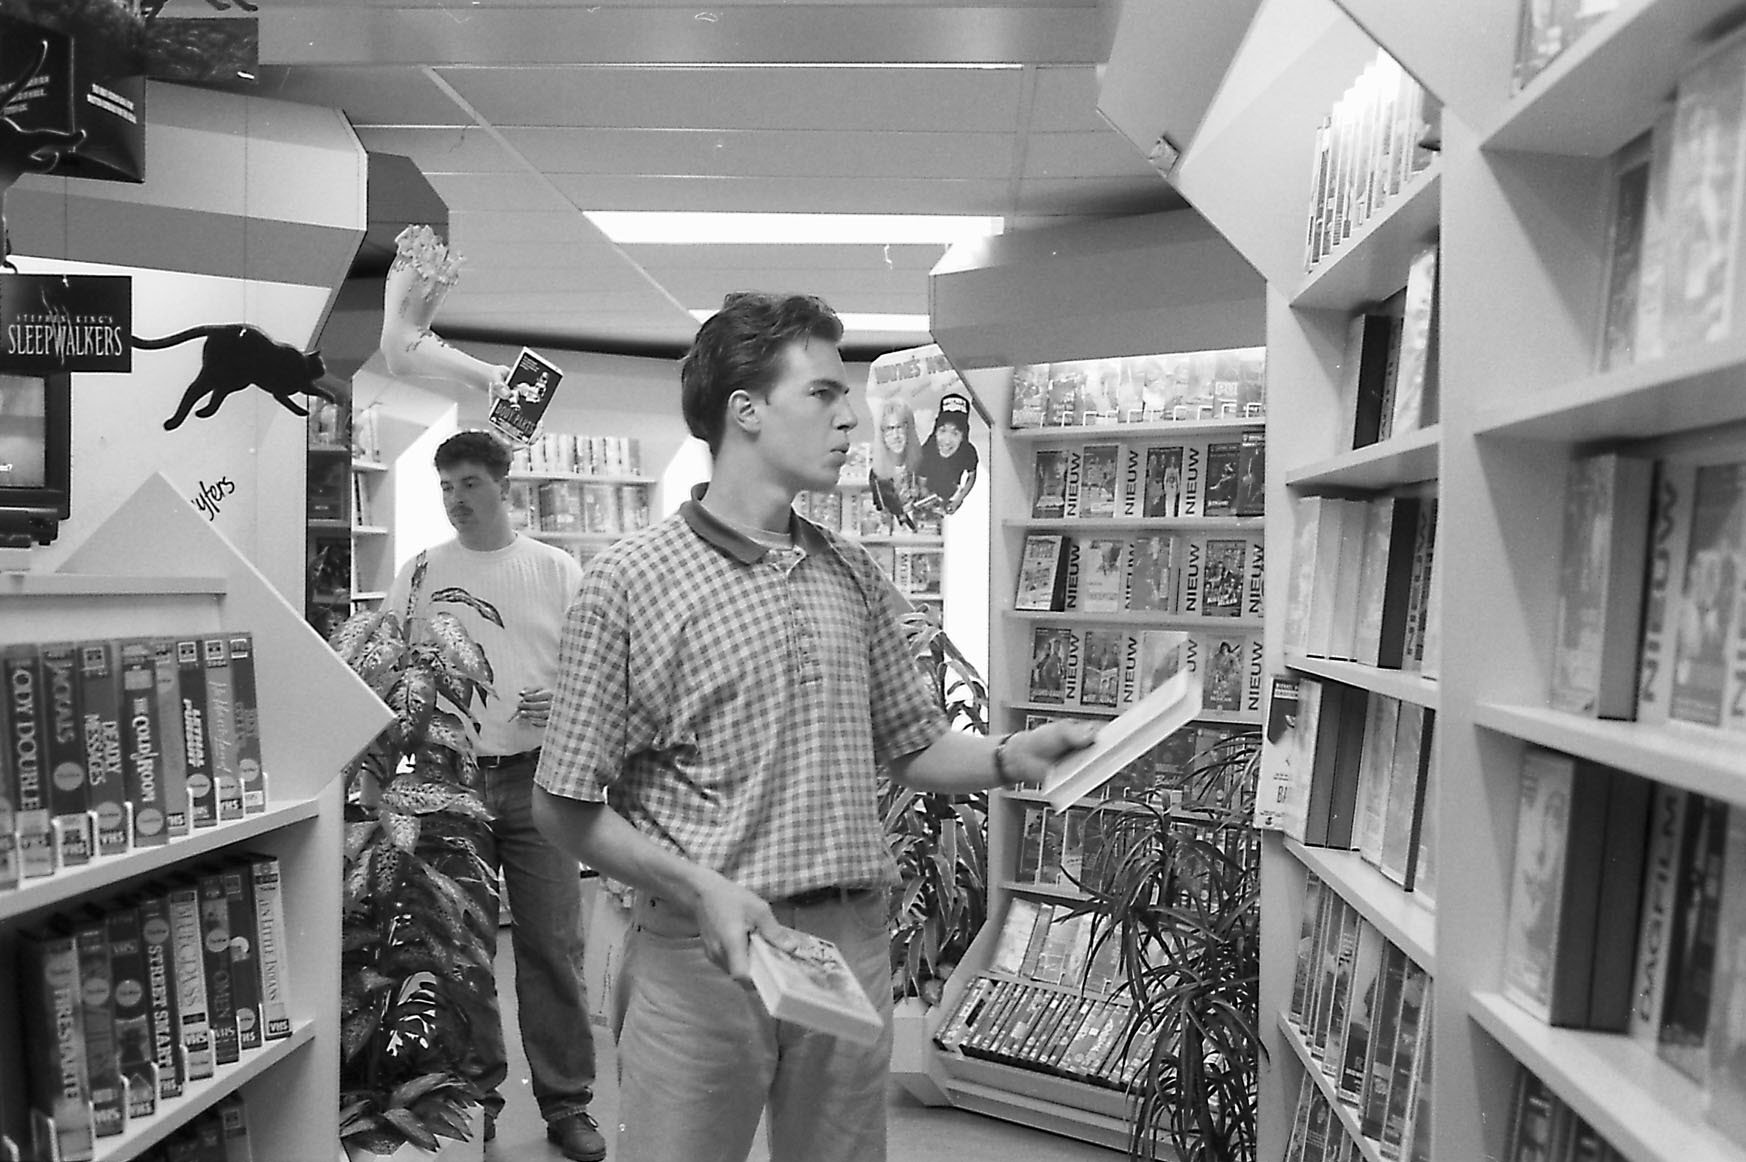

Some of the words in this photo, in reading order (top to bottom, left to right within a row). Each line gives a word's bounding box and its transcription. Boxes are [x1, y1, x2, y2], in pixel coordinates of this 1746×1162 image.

[8, 324, 122, 358] SLEEPWALKERS
[1067, 452, 1081, 516] NIEUW
[1124, 450, 1139, 516] NIEUW
[1185, 448, 1200, 515] NIEUW
[1067, 545, 1080, 609] NIEUW
[1186, 544, 1200, 611] NIEUW
[1249, 544, 1264, 613] NIEUW
[1066, 634, 1080, 699] NIEUW
[1123, 637, 1138, 703] NIEUW
[1248, 641, 1263, 711] NIEUW
[16, 721, 41, 809] DOUBLE
[83, 713, 106, 786] MESSAGES
[102, 720, 122, 773] DEADLY
[136, 759, 156, 802] ROOM
[148, 944, 168, 1008] STREET
[265, 960, 281, 1001] INDIANS
[154, 1010, 173, 1067] SMART
[240, 1031, 257, 1044] HS
[269, 1021, 288, 1034] VHS
